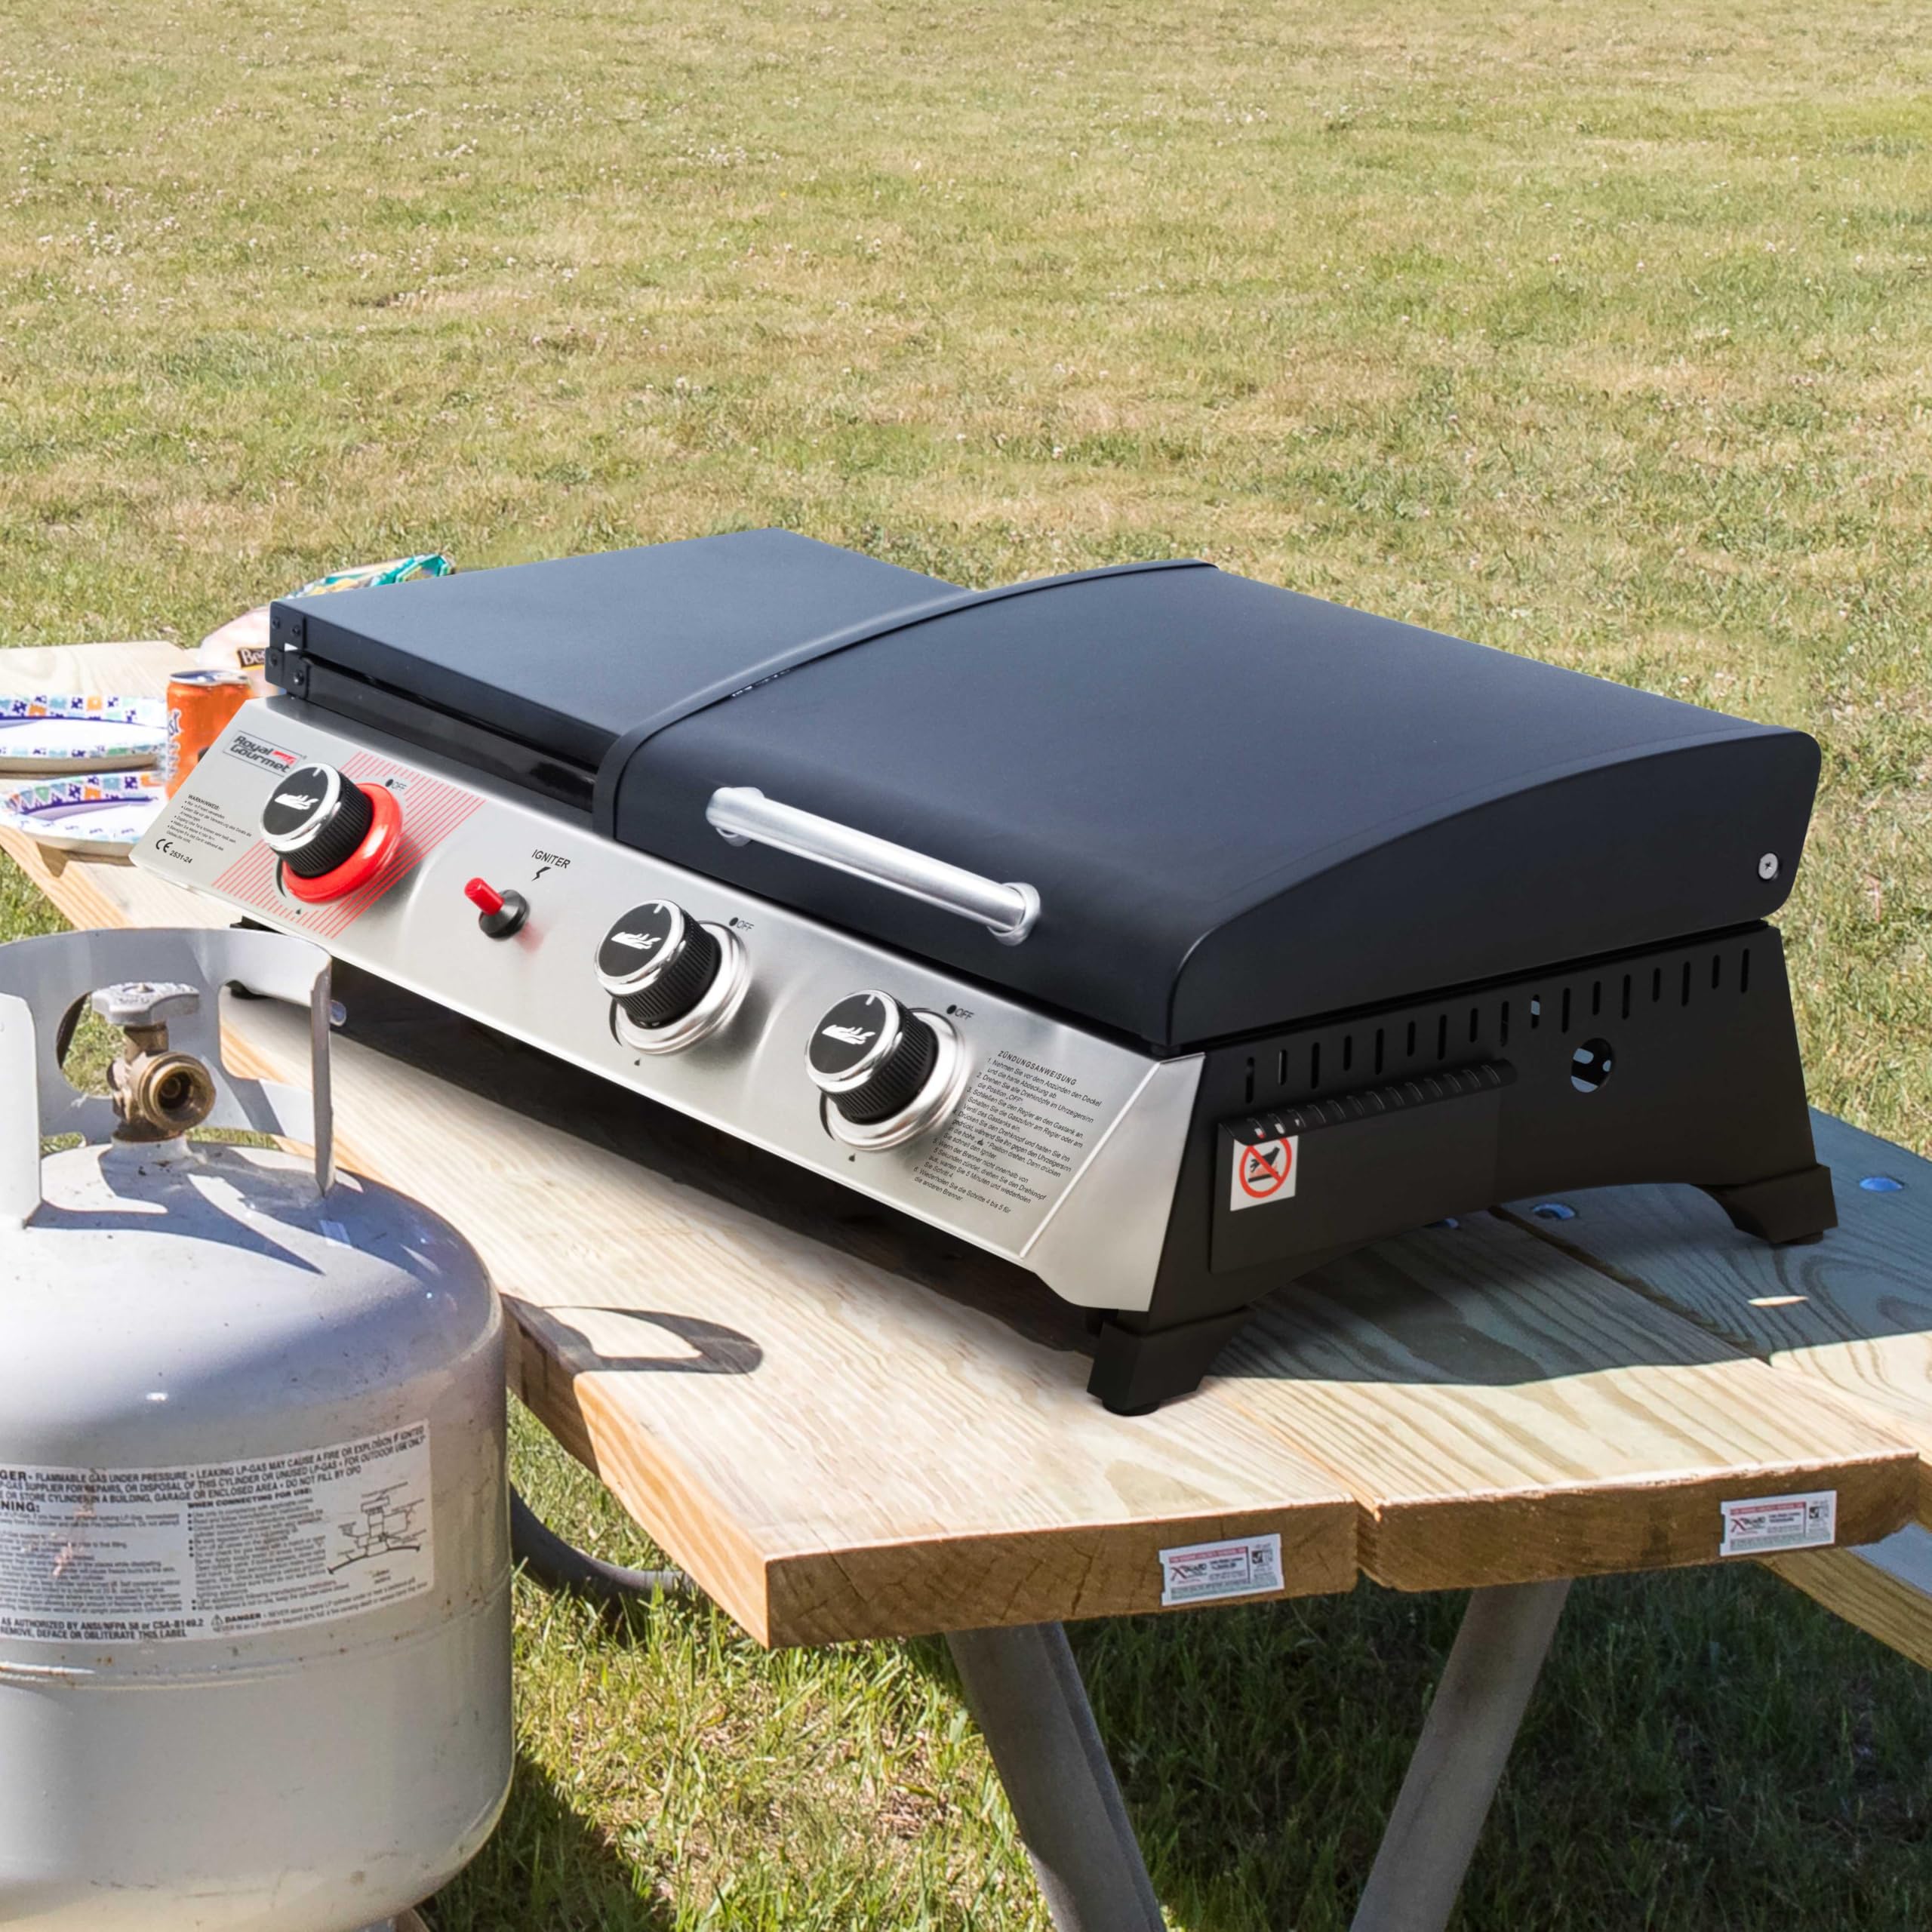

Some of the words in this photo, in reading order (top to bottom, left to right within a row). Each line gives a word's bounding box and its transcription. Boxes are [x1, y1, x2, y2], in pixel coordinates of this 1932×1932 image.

[233, 735, 274, 755] Royal
[230, 744, 291, 773] Gourmet
[391, 781, 408, 792] OFF
[170, 850, 193, 864] 2531-24
[531, 849, 571, 869] IGNITER
[737, 920, 755, 932] OFF
[955, 1008, 974, 1020] OFF
[998, 1050, 1077, 1085] ZÜNDUNGSANWEISUNG
[986, 1066, 998, 1075] und
[1005, 1074, 1020, 1084] harte
[1019, 1080, 1049, 1097] Abdeckung
[986, 1084, 1007, 1097] Position
[992, 1059, 1015, 1072] Nehmen
[1032, 1075, 1045, 1084] dem
[1070, 1091, 1082, 1099] den
[1081, 1095, 1102, 1107] Deckel
[982, 1074, 1002, 1086] Drehen
[1001, 1081, 1011, 1090] Sie
[1010, 1085, 1020, 1094] alle
[1019, 1090, 1051, 1107] Drehknöpfe
[1056, 1104, 1094, 1125] Uhrzeigersinn
[962, 1103, 978, 1113] Ventil
[977, 1109, 988, 1118] des
[986, 1113, 1012, 1128] Gastanks
[967, 1096, 990, 1109] Schalten
[989, 1105, 999, 1113] Sie
[998, 1109, 1008, 1117] die
[1007, 1112, 1035, 1128] Gaszufuhr
[1041, 1128, 1062, 1140] Regler
[1060, 1134, 1074, 1144] oder
[1006, 1103, 1018, 1111] den
[1016, 1107, 1035, 1120] Regler
[1041, 1117, 1054, 1126] den
[1052, 1121, 1075, 1135] Gastank
[952, 1136, 971, 1148] schnell
[969, 1143, 981, 1152] den
[987, 1123, 999, 1131] den
[997, 1128, 1026, 1144] Drehknopf
[1024, 1138, 1035, 1147] und
[1035, 1143, 1052, 1154] halten
[1051, 1149, 1062, 1158] Sie
[961, 1131, 976, 1140] hohe
[1026, 1158, 1041, 1168] Dann
[1040, 1164, 1061, 1177] drücken
[961, 1150, 982, 1162] Brenner
[981, 1159, 995, 1168] nicht
[994, 1164, 1019, 1179] innerhalb
[1010, 1143, 1028, 1155] gegen
[1026, 1149, 1038, 1158] den
[1035, 1153, 1072, 1174] Uhrzeigersinn
[932, 1165, 949, 1176] Schritt
[937, 1149, 963, 1164] Sekunden
[980, 1168, 999, 1180] drehen
[1007, 1180, 1020, 1189] den
[1017, 1185, 1047, 1201] Drehknopf
[918, 1169, 949, 1186] Wiederholen
[949, 1182, 958, 1190] Sie
[957, 1186, 967, 1194] die
[966, 1190, 986, 1202] Schritte
[989, 1200, 999, 1208] bis
[921, 1179, 943, 1192] anderen
[969, 1173, 991, 1186] Minuten
[989, 1182, 1001, 1190] und
[999, 1186, 1032, 1204] wiederholen
[26, 1482, 65, 1491] SUPPLIER
[140, 1481, 181, 1492] DISPOSAL
[217, 1474, 260, 1487] CYLINDER
[35, 1472, 85, 1483] FLAMMABLE
[109, 1473, 138, 1483] UNDER
[141, 1471, 187, 1481] PRESSURE
[196, 1466, 234, 1479] LEAKING
[235, 1463, 266, 1475] LP-GAS
[269, 1460, 286, 1470] MAY
[154, 1491, 190, 1502] GARAGE
[208, 1484, 254, 1498] ENCLOSED
[255, 1481, 277, 1492] AREA
[14, 1619, 65, 1629] AUTHORIZED
[225, 1612, 261, 1623] DANGER
[36, 1629, 67, 1638] DEFACE
